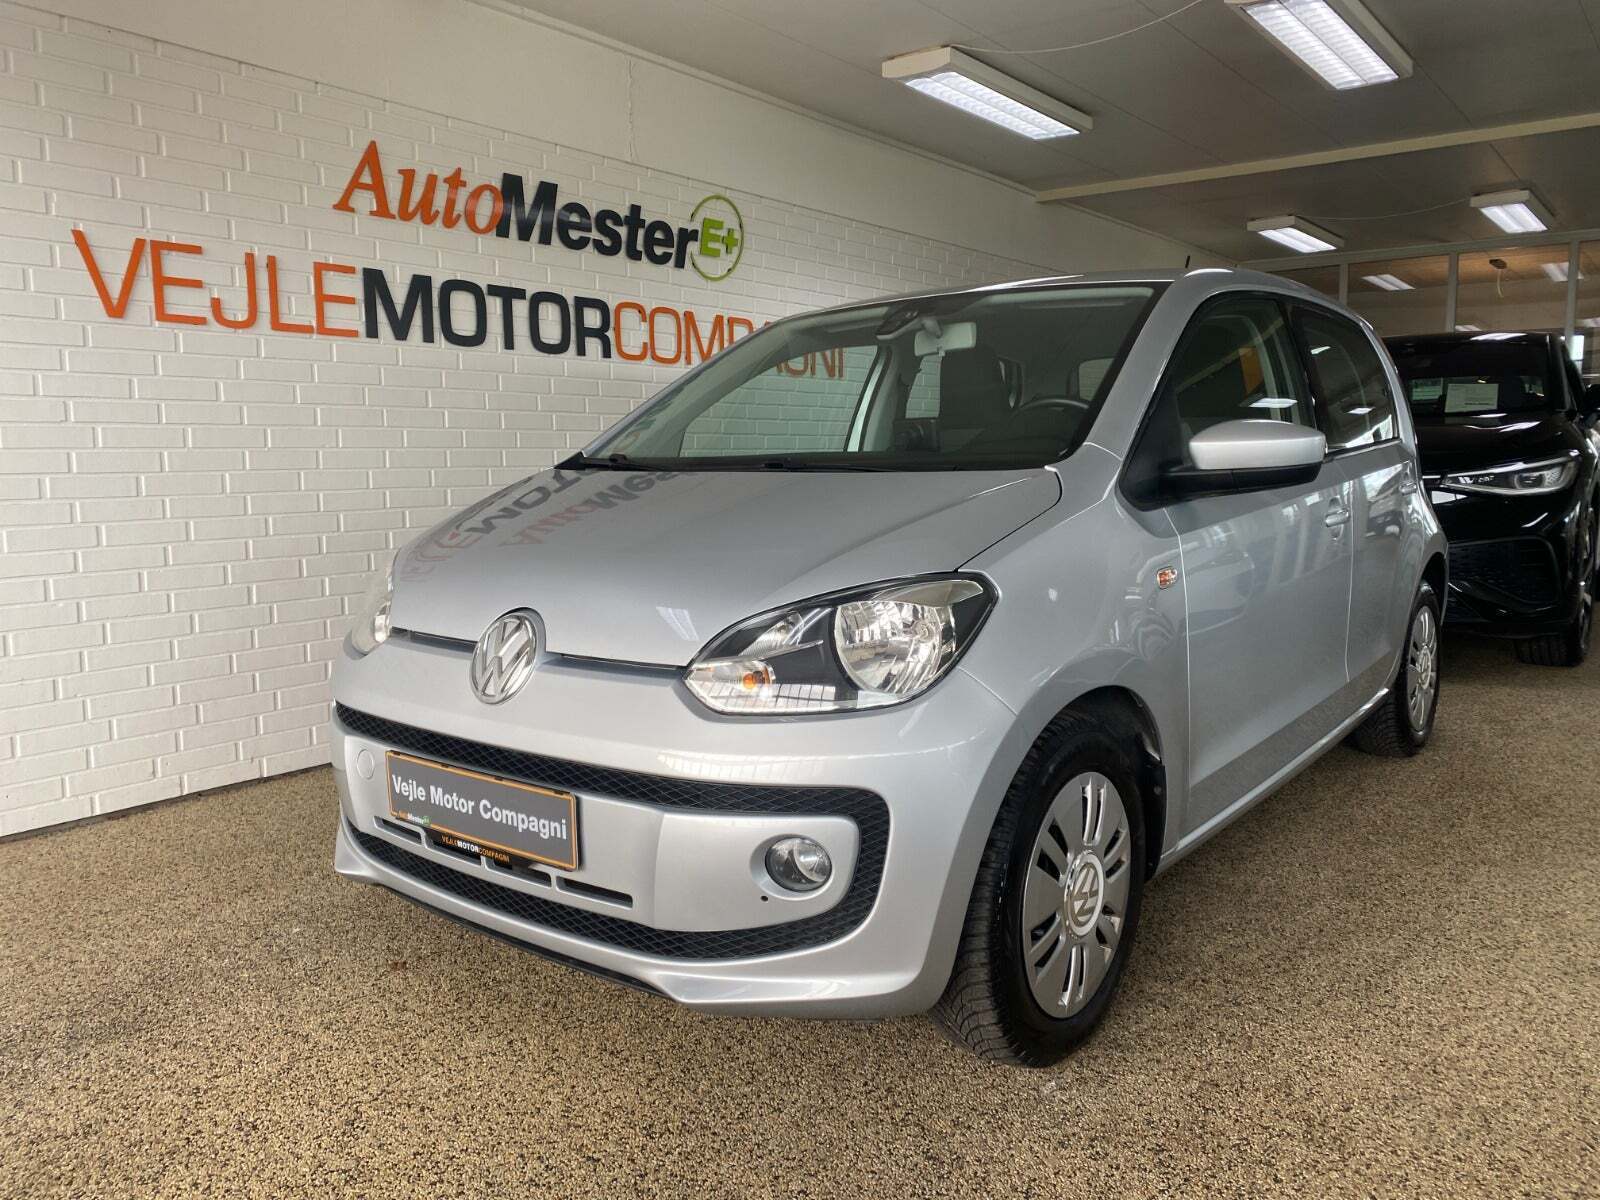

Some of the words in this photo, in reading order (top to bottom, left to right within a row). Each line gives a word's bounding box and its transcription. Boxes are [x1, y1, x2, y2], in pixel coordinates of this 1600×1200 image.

[333, 140, 698, 269] AutoMester
[391, 774, 426, 802] Vejle
[429, 785, 475, 815] Motor
[479, 800, 567, 839] Compagni
